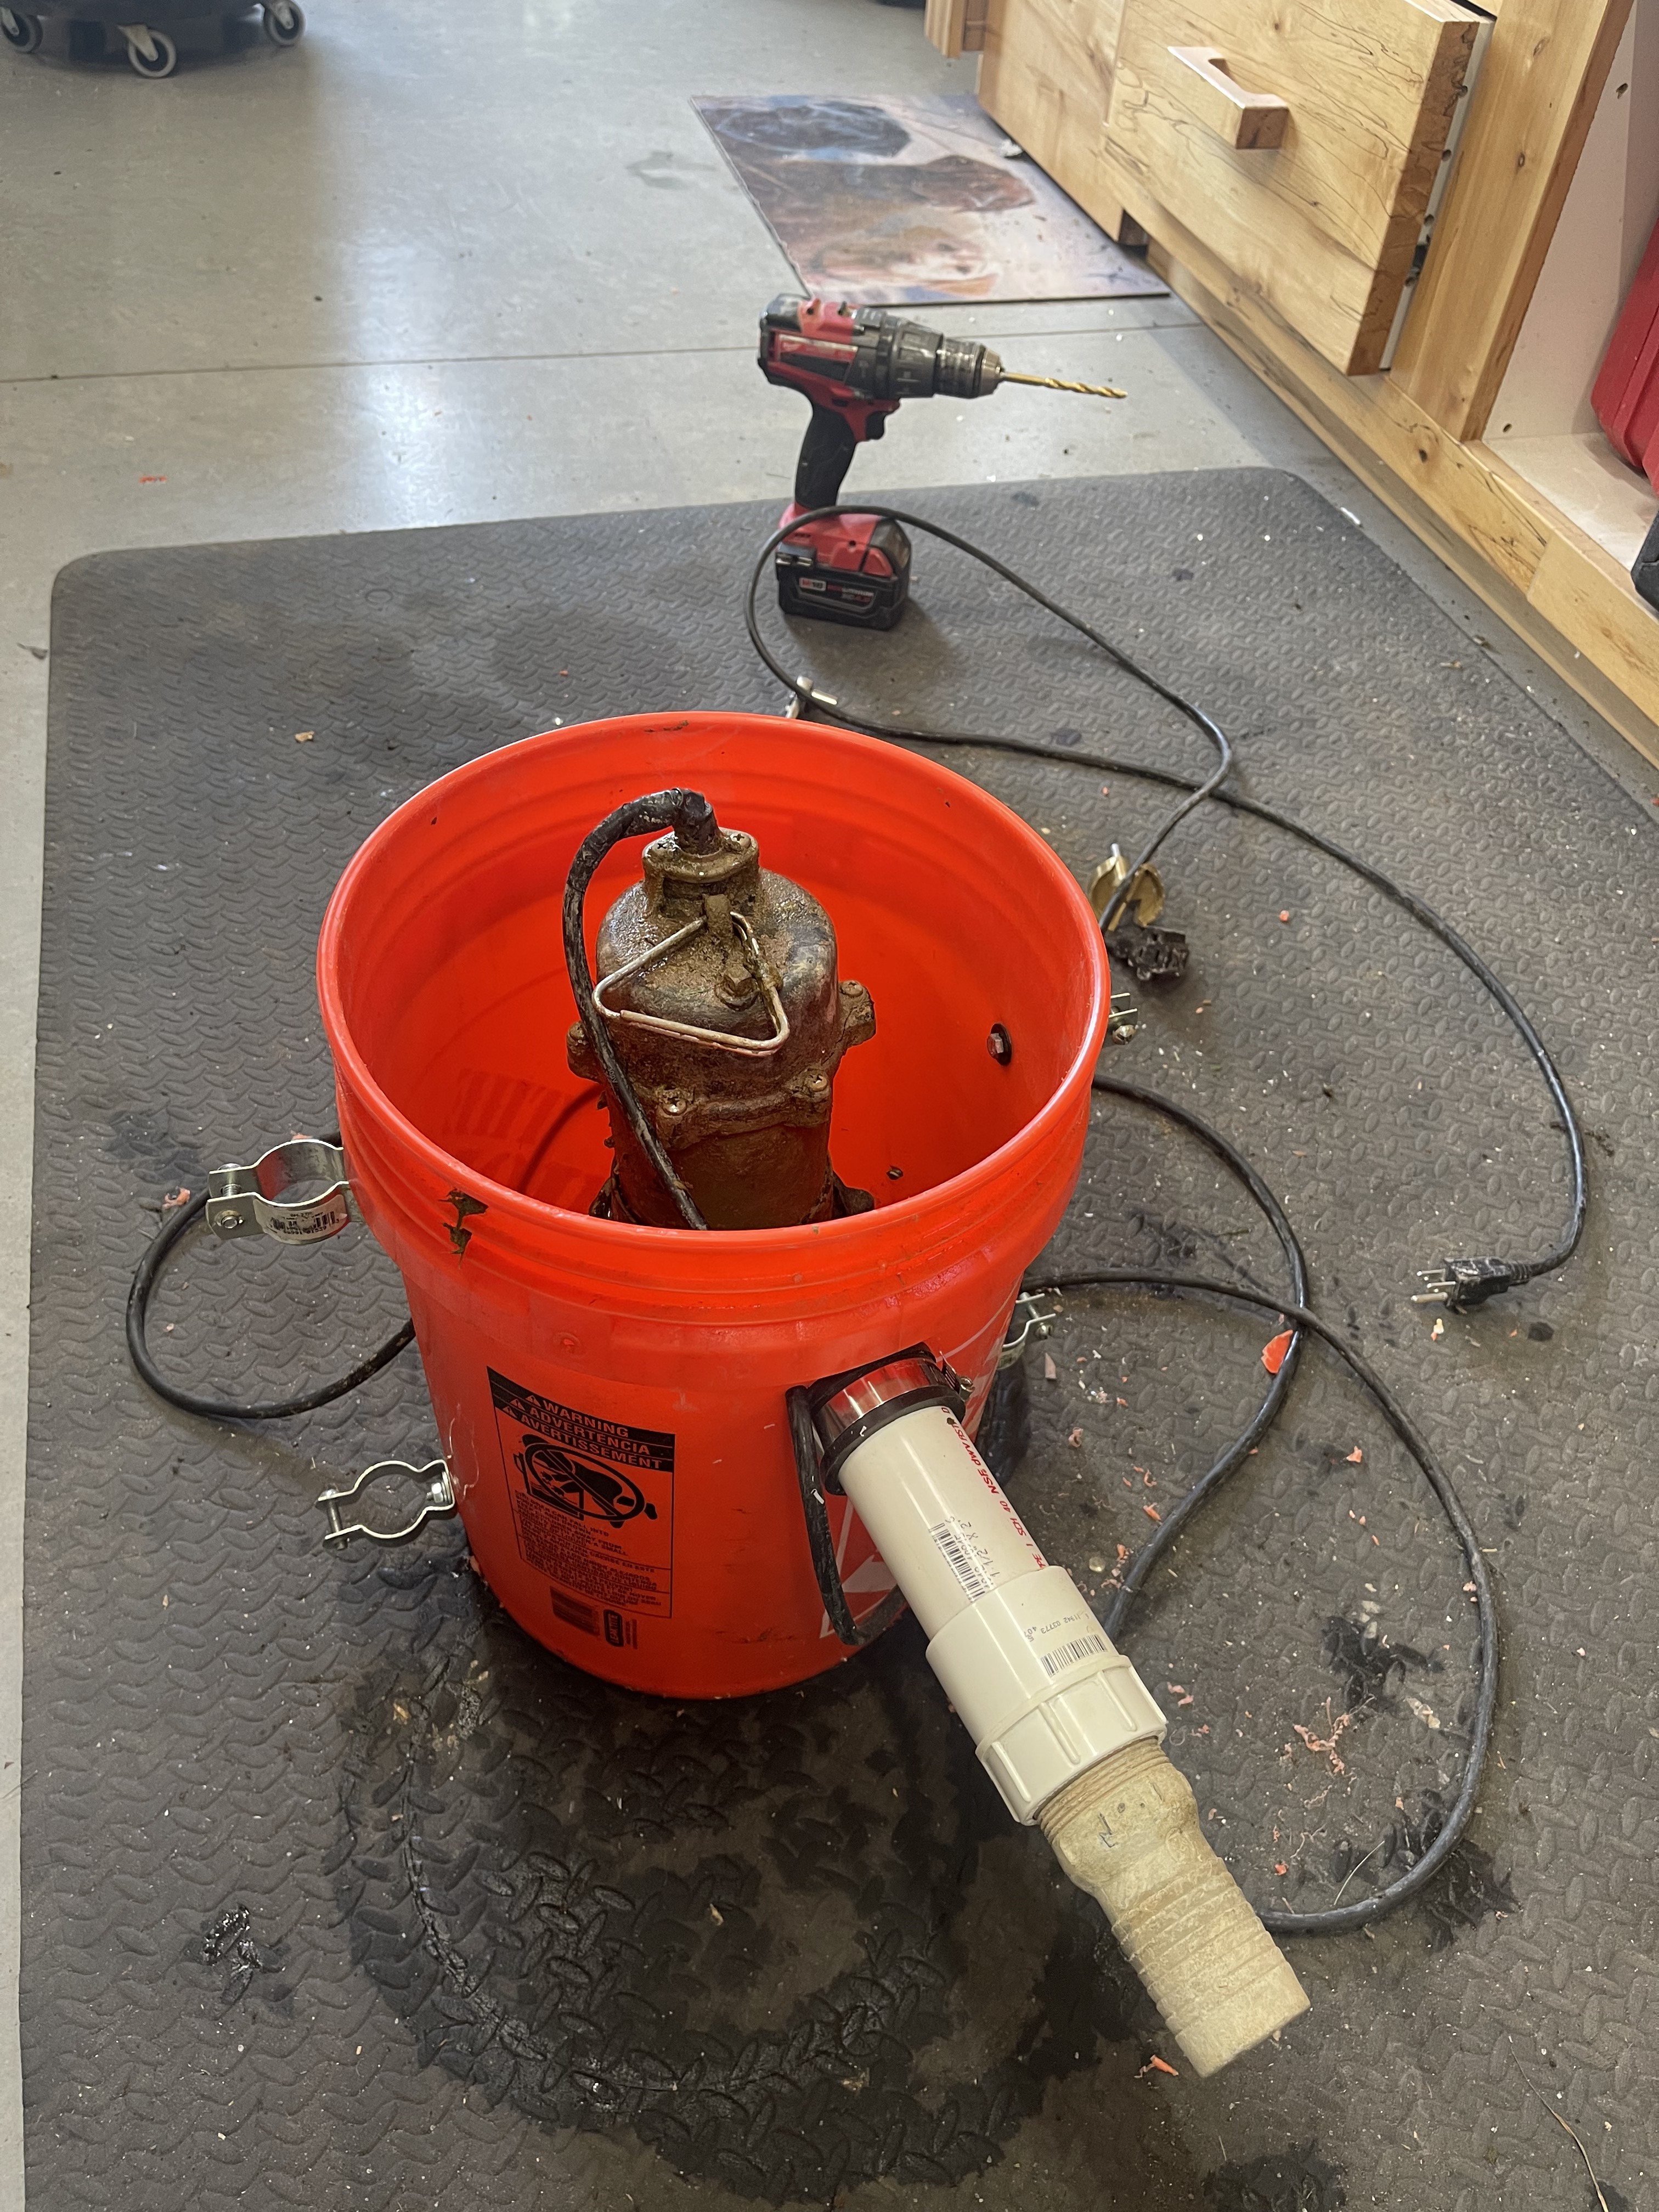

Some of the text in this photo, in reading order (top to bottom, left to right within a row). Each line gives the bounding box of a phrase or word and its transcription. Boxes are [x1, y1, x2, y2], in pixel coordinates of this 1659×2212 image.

[542, 1399, 629, 1437] WARNING
[529, 1407, 651, 1455] ADVERTENCIA
[521, 1414, 662, 1469] AVERTISSEMENT
[1000, 1500, 1011, 1513] 40
[1010, 1517, 1026, 1536] SCH
[1032, 1553, 1046, 1568] PE
[1040, 1620, 1062, 1634] 03773
